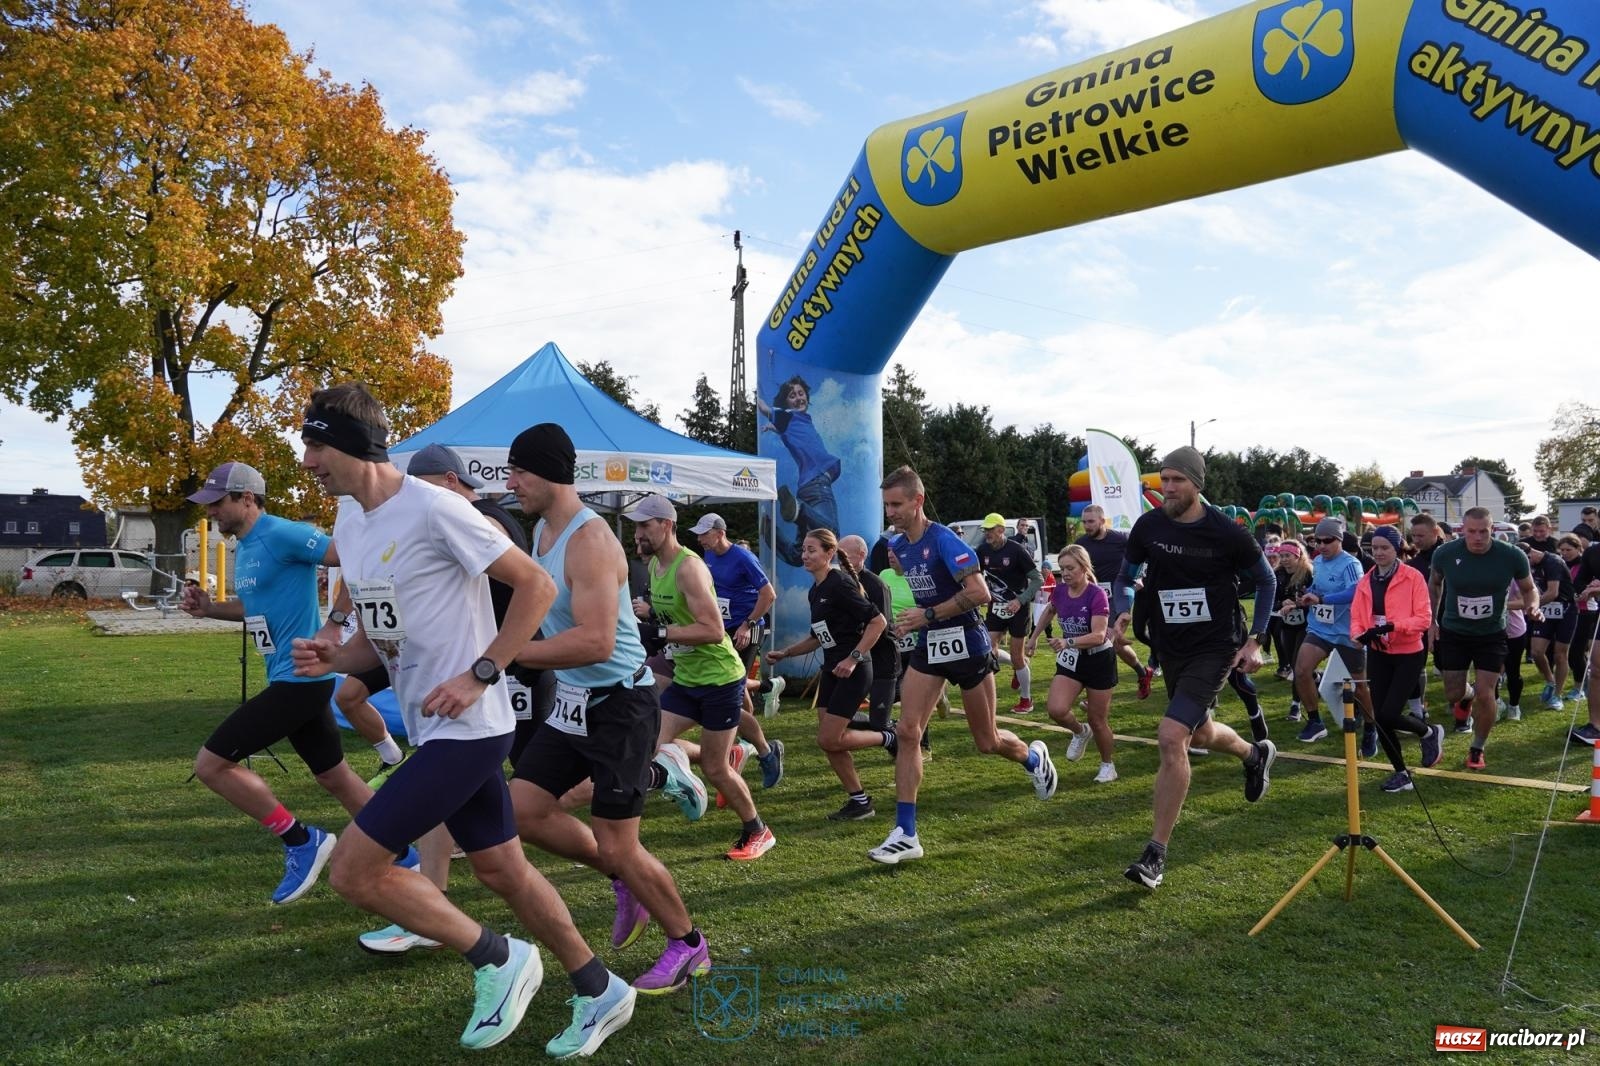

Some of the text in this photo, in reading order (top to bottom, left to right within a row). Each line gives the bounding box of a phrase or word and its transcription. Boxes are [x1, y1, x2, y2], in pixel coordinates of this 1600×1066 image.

[1025, 45, 1173, 108] Gmina
[988, 68, 1215, 157] Pietrowice
[1409, 42, 1600, 179] aktywny
[1016, 122, 1190, 186] Wielkie
[768, 174, 862, 331] Gmina ludzi
[785, 203, 882, 352] aktywnych
[733, 477, 759, 488] MITKO
[1163, 601, 1204, 617] 757
[1313, 605, 1332, 619] 747
[1460, 604, 1491, 616] 712
[1541, 607, 1561, 616] 718
[928, 638, 964, 658] 760
